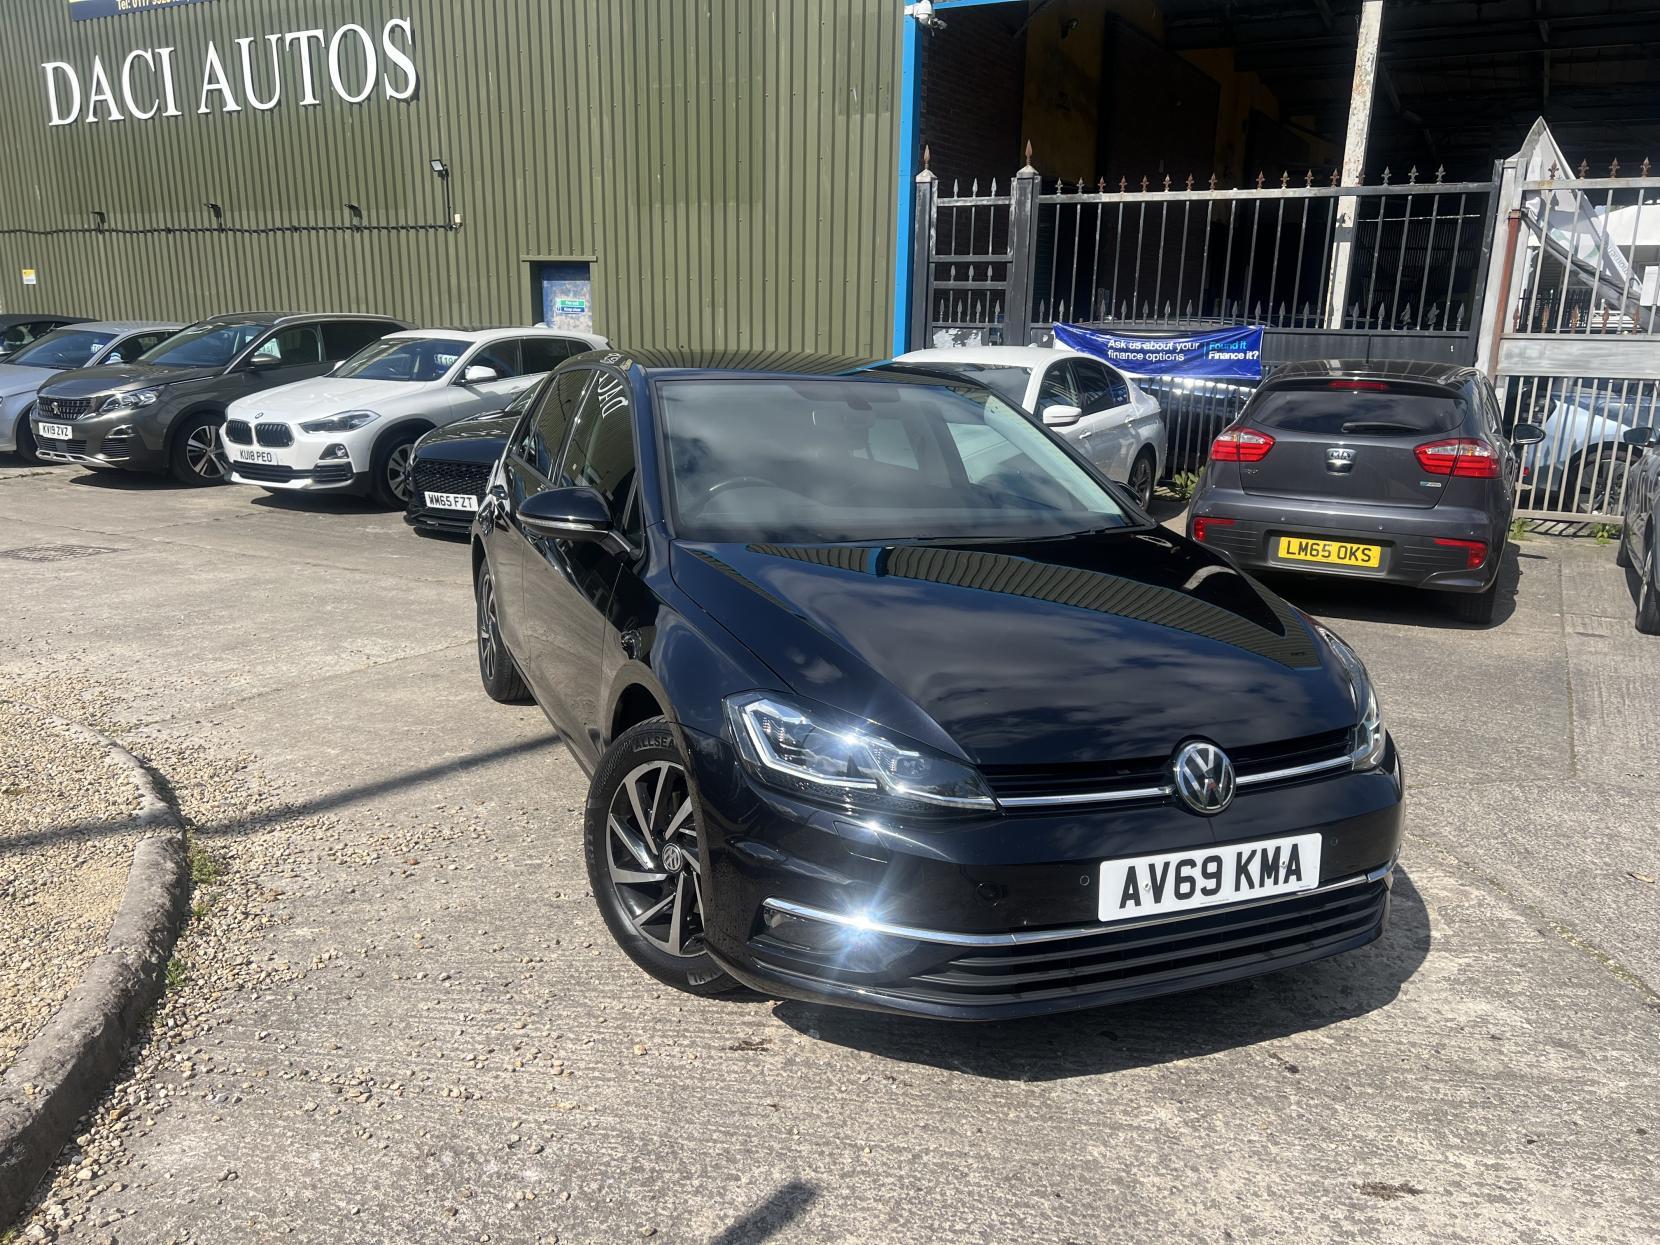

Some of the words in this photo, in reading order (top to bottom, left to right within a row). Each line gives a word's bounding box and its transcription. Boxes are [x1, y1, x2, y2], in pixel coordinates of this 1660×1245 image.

[41, 47, 183, 126] DACI
[197, 16, 418, 114] AUTOS
[1108, 340, 1126, 349] Ask
[1129, 341, 1141, 349] us
[1143, 341, 1174, 350] about
[1176, 342, 1200, 352] your
[1209, 341, 1239, 350] Found
[1240, 341, 1247, 349] it
[1108, 350, 1143, 360] finance
[1145, 352, 1185, 362] options
[1208, 351, 1245, 360] Finance
[1246, 351, 1259, 360] it?
[427, 493, 452, 507] WM65
[453, 496, 473, 509] FZT
[1286, 540, 1332, 558] LM65
[1337, 545, 1372, 562] OKS
[1118, 854, 1224, 910] AV69
[1234, 843, 1303, 892] KMA
